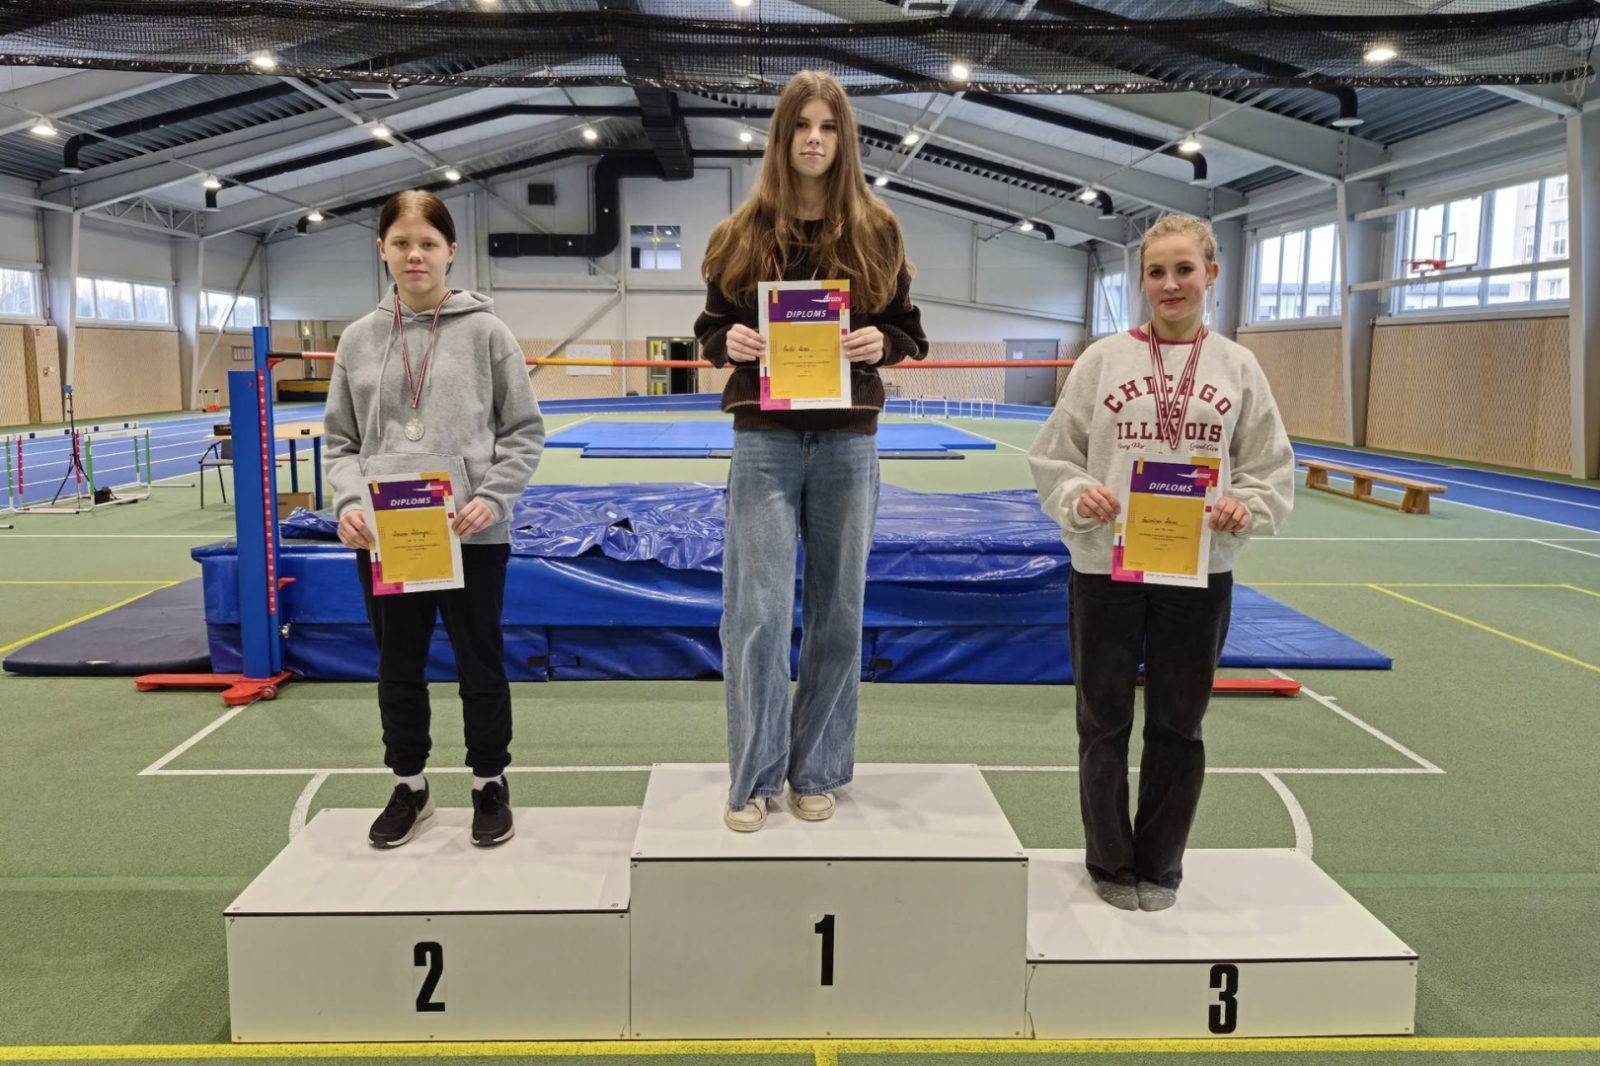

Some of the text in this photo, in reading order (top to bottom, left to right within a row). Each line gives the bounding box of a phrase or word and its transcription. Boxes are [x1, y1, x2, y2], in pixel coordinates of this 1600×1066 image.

[786, 309, 827, 319] DIPLOMS
[1103, 374, 1232, 416] CHICAGO
[1116, 421, 1222, 443] ILLINOIS
[390, 497, 431, 507] DIPLOMS
[1148, 482, 1193, 493] DIPLOMS
[814, 914, 836, 986] 1
[413, 941, 446, 1013] 2
[1208, 964, 1239, 1035] 3
